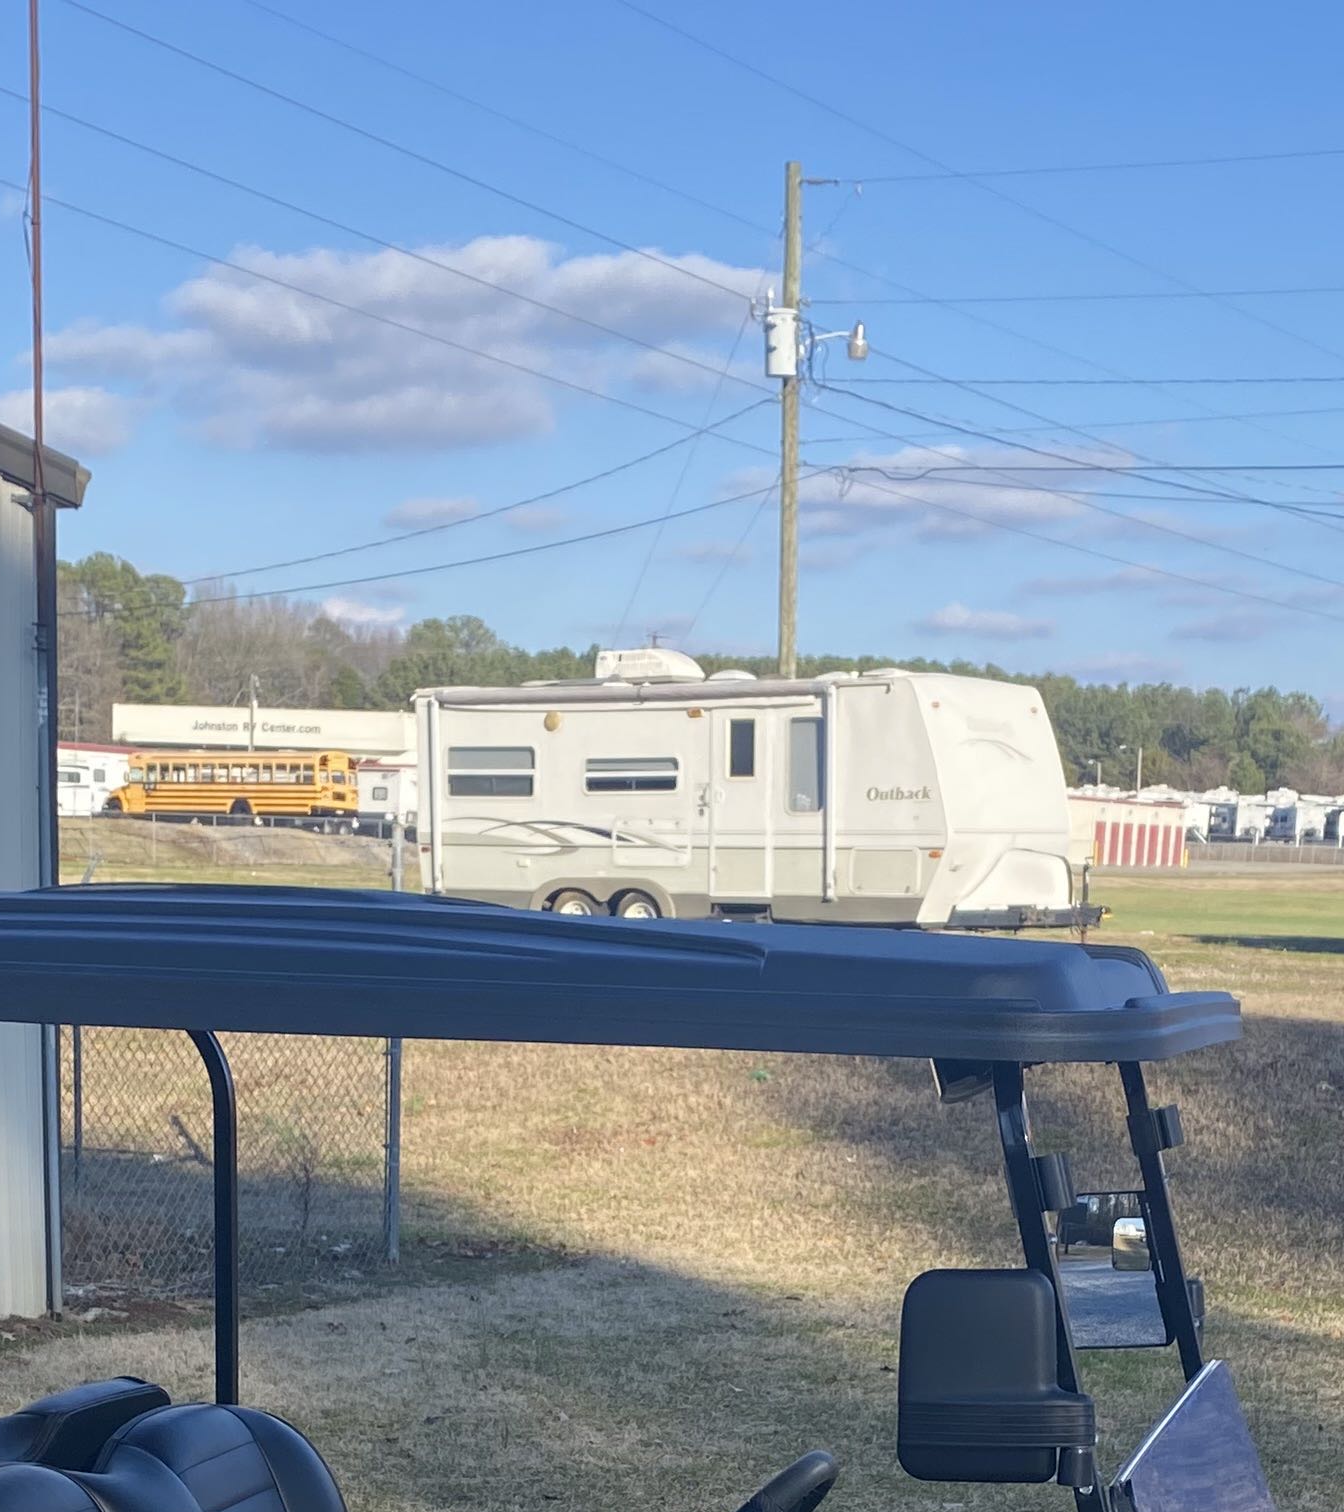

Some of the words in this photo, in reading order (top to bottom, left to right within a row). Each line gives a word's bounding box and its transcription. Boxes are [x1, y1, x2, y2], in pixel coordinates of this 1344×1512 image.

[192, 720, 238, 731] Johnston
[261, 722, 321, 735] Center.com
[866, 786, 931, 801] Outback
